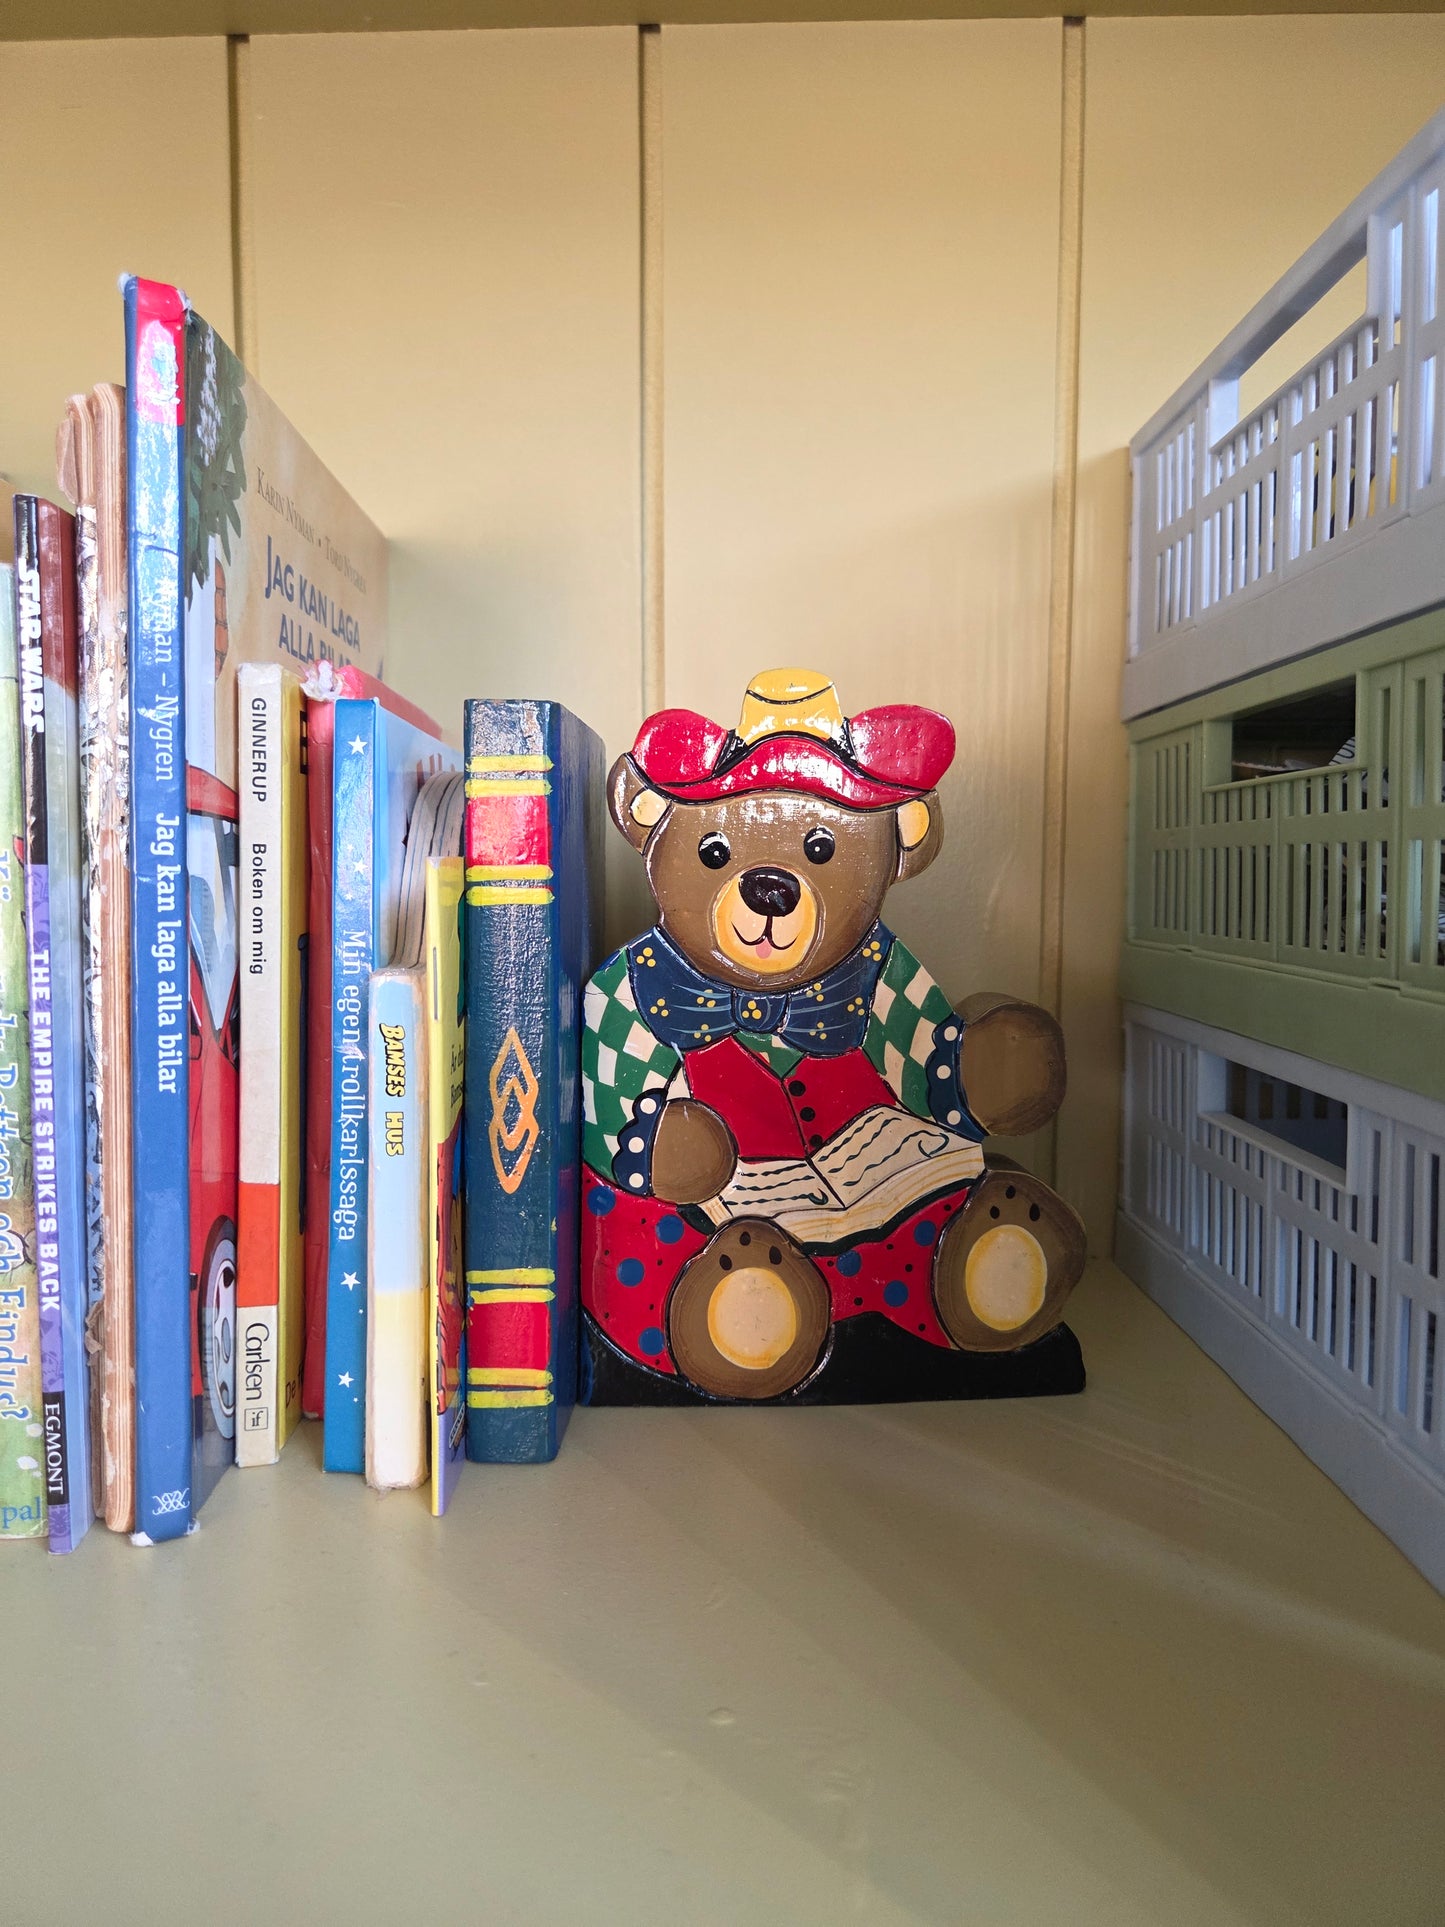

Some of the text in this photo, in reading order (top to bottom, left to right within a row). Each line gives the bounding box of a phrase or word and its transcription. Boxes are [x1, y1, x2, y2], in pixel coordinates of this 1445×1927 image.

[257, 467, 285, 515] KARIN
[286, 496, 315, 545] NYMAN
[18, 557, 45, 733] STAR WARS
[279, 613, 315, 664] ALLA
[299, 574, 327, 629] KAN
[331, 601, 360, 653] LAGA
[149, 695, 179, 782] Nygren
[251, 697, 267, 802] GINNERUP
[151, 812, 183, 1093] Jag kan laga alla bilar
[249, 843, 267, 974] Boken om mig
[33, 950, 60, 1311] THE EMPIRE STRIKES BACK
[333, 929, 366, 1241] Min egen trollkarlssaga
[380, 1023, 405, 1156] BAMSES HUS
[245, 1322, 270, 1400] Carlsen
[44, 1403, 64, 1495] EGMONT
